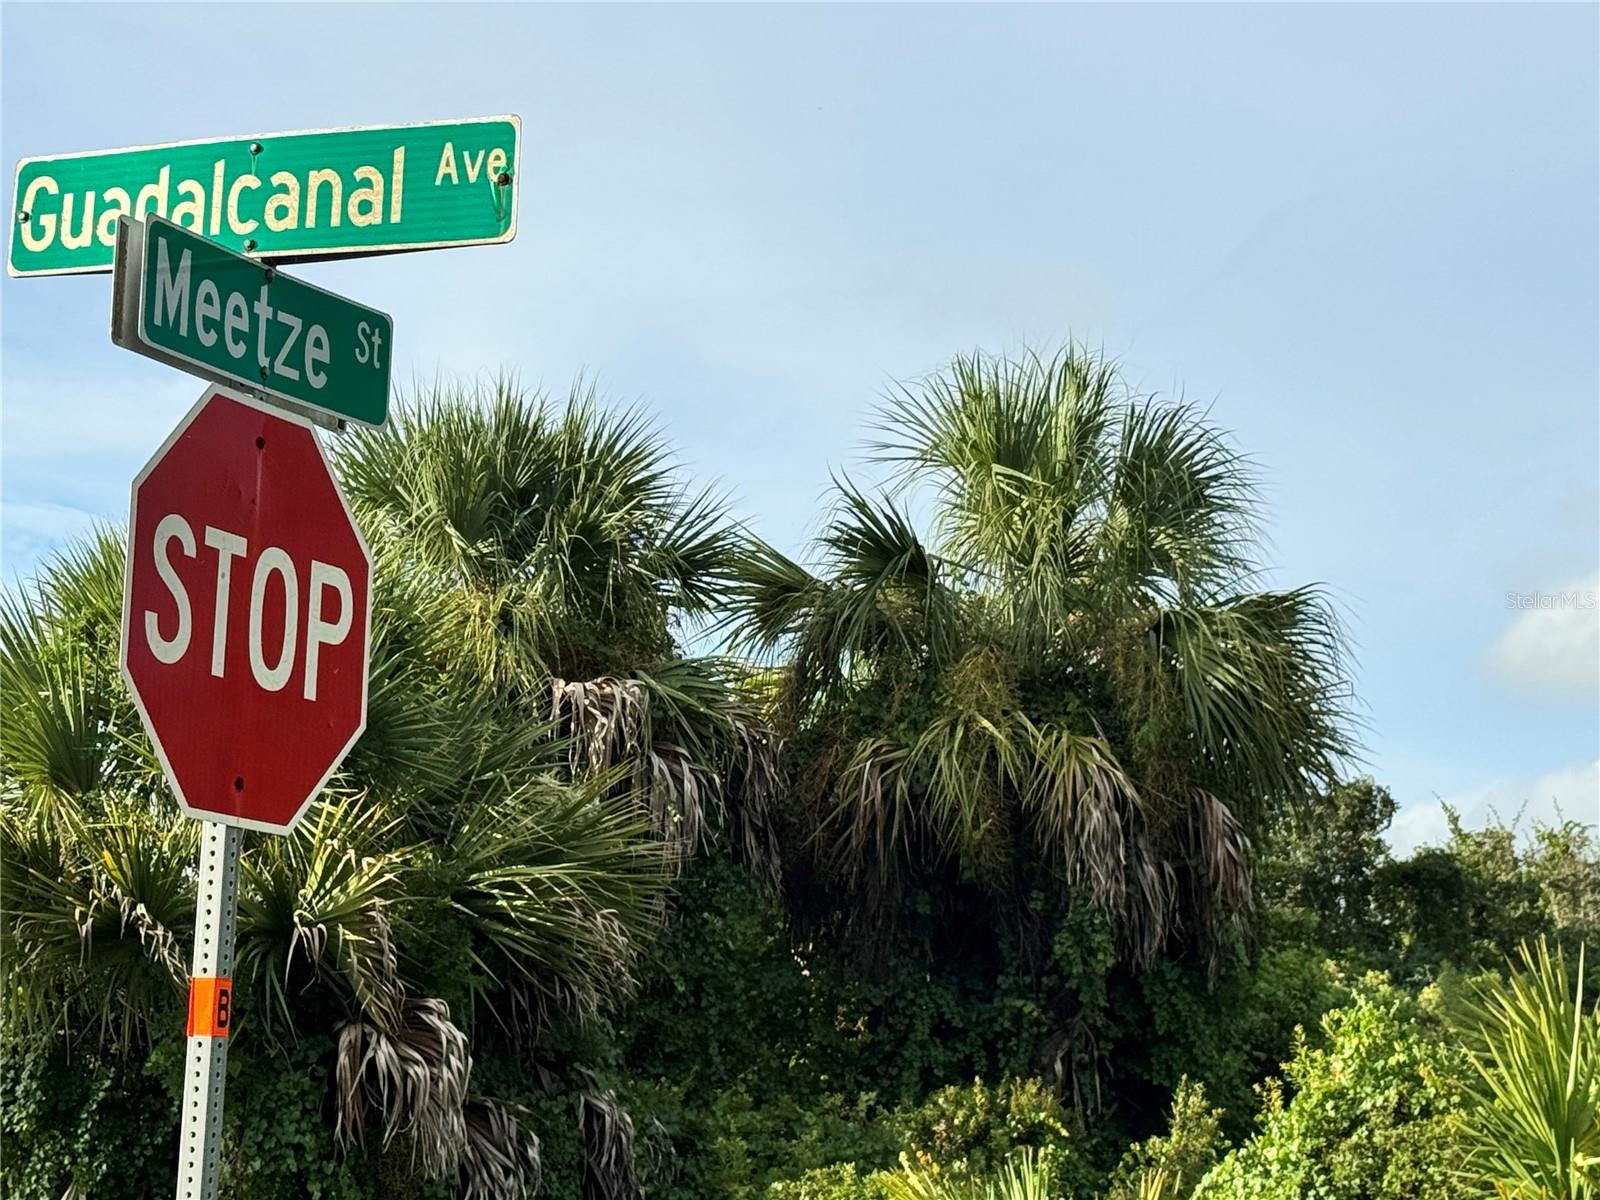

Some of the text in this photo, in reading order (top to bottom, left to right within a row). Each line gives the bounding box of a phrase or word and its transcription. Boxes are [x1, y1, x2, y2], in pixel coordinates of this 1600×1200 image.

[20, 142, 507, 252] Guadalcanal Ave
[153, 237, 383, 389] Meetze St
[145, 513, 354, 702] STOP
